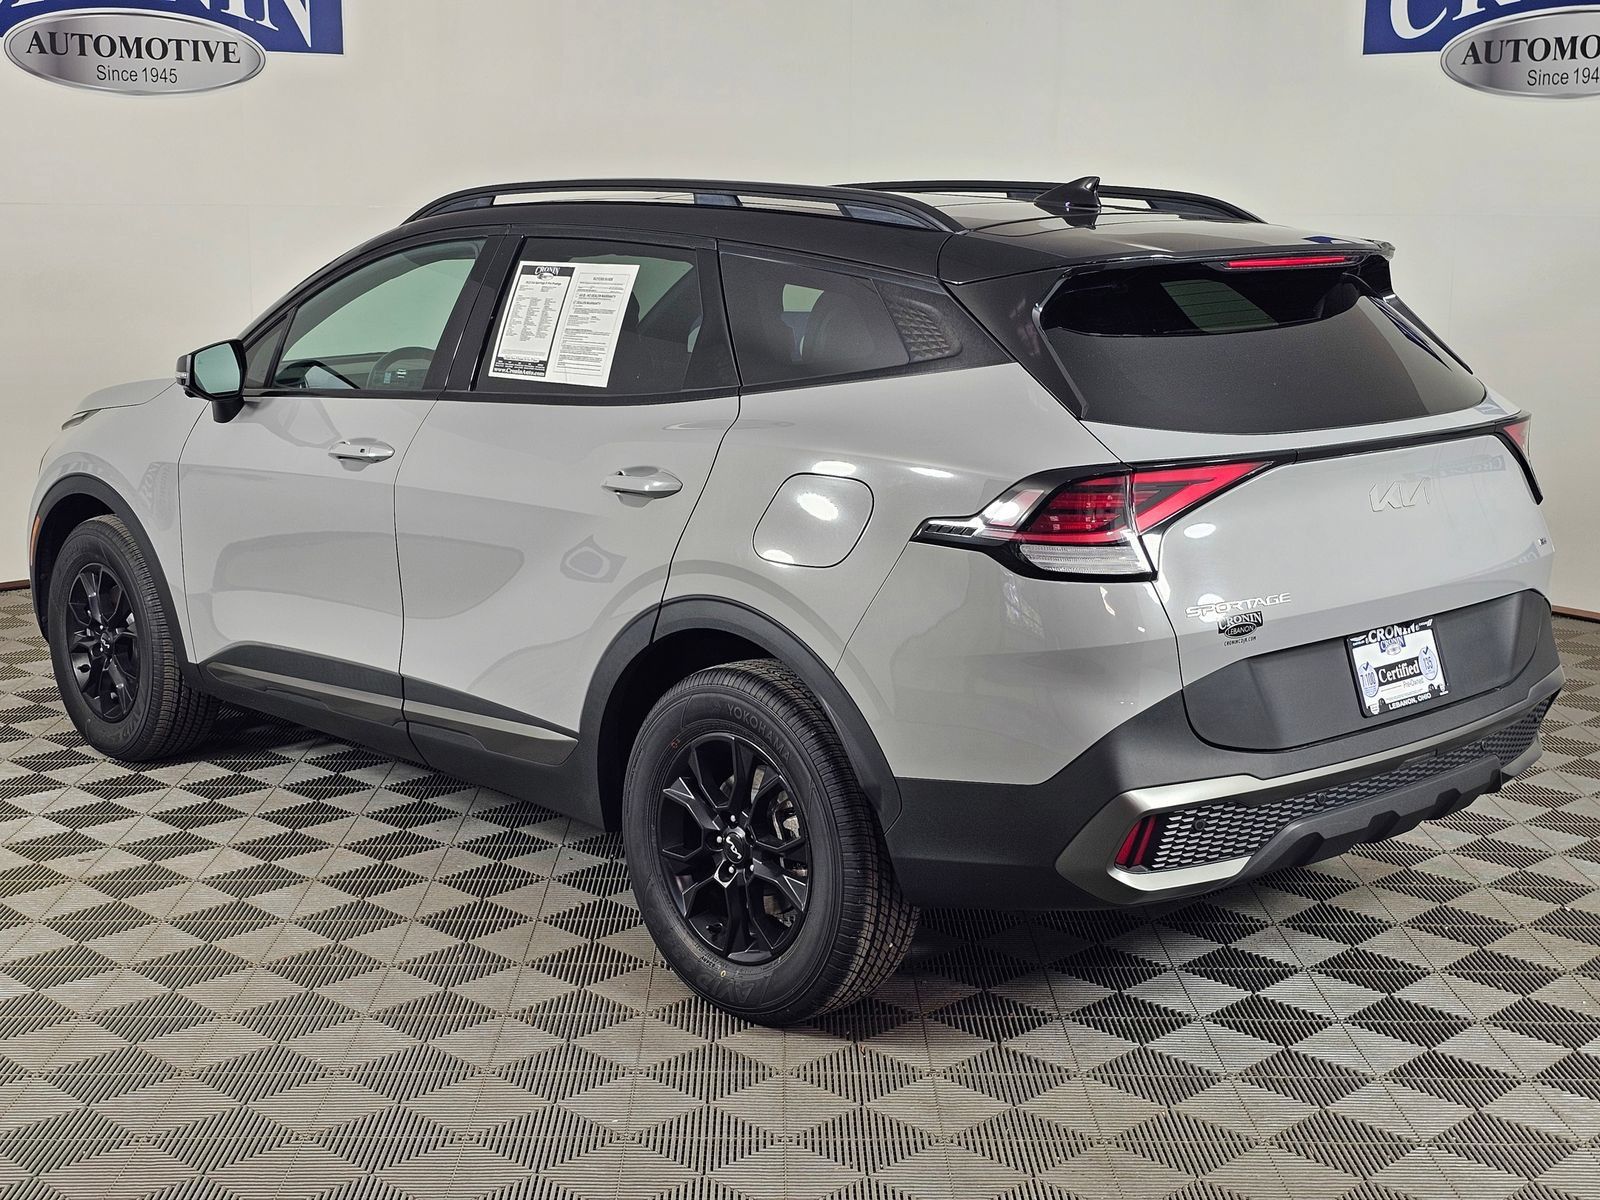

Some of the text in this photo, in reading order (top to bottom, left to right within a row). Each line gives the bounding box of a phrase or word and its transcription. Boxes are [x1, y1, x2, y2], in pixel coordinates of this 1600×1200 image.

[26, 31, 241, 64] AUTOMOTIVE
[96, 65, 178, 84] Since 1945
[1527, 69, 1569, 86] Since
[1185, 593, 1291, 618] SPORTAGE
[1218, 612, 1262, 630] CRONIN
[1227, 624, 1254, 636] LEBANON
[1367, 623, 1416, 643] CRONIN
[1378, 660, 1420, 683] Certified
[1388, 697, 1418, 710] LEBANON,
[1417, 693, 1432, 702] OHIO
[727, 703, 790, 762] YOKOHAMA
